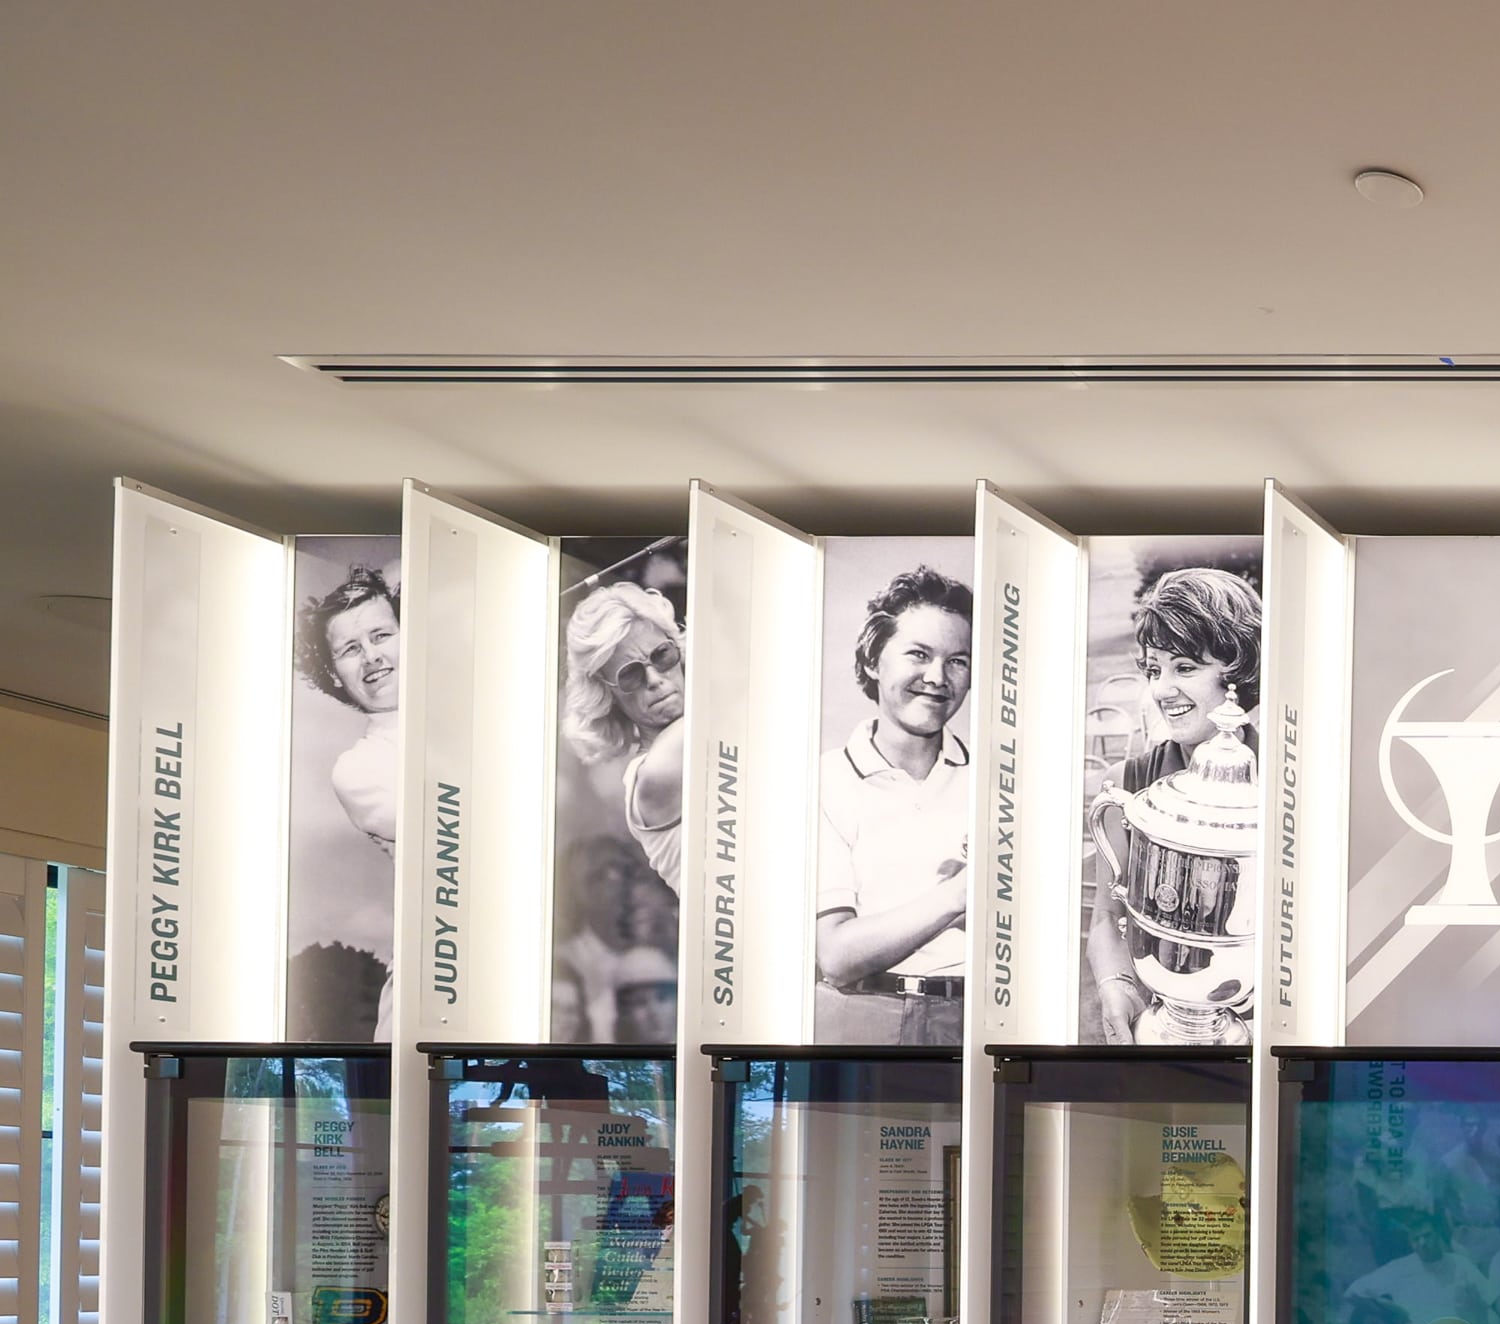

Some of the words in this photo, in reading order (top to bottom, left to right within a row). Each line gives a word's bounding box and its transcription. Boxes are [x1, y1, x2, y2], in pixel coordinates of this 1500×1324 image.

[1000, 582, 1021, 728] BERNING
[155, 721, 183, 800] BELL
[1282, 703, 1298, 869] INDUCTEE
[716, 740, 739, 862] HAYNIE
[997, 737, 1016, 902] MAXWELL
[153, 808, 181, 887] KIRK
[435, 782, 461, 908] RANKIN
[150, 893, 179, 1003] PEGGY
[434, 915, 459, 1004] JUDY
[714, 873, 735, 1007] SANDRA
[995, 911, 1012, 1007] SUSIE
[1279, 877, 1294, 1008] FUTURE
[313, 1147, 344, 1157] BELL
[314, 1121, 355, 1132] PEGGY
[314, 1134, 343, 1145] KIRK
[598, 1123, 631, 1134] JUDY
[598, 1136, 645, 1147] RANKIN
[880, 1126, 931, 1137] SANDRA
[880, 1139, 924, 1150] HAYNIE
[1162, 1126, 1198, 1138] SUSIE
[1162, 1139, 1226, 1150] MAXWELL
[1162, 1152, 1216, 1163] BERNING
